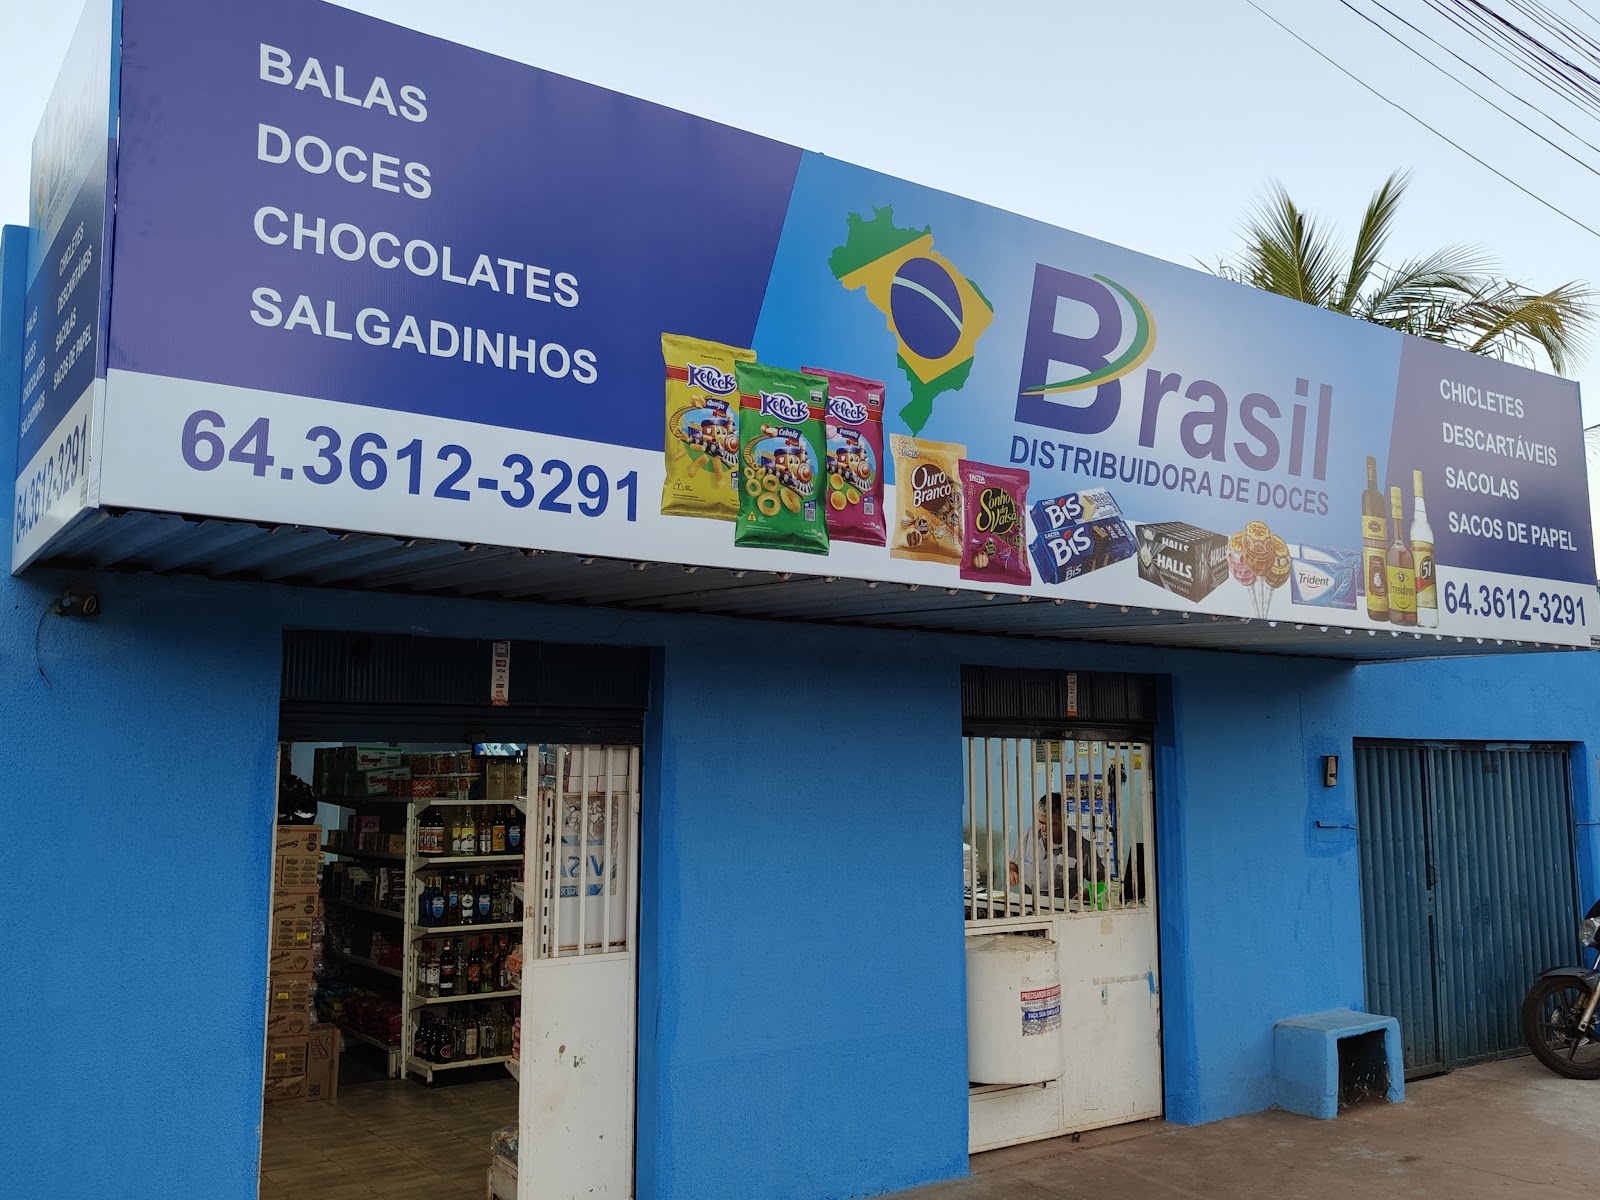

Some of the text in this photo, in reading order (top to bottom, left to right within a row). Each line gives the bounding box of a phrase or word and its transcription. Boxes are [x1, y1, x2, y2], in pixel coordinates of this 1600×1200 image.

[259, 42, 428, 123] BALAS
[257, 122, 432, 200] DOCES
[253, 206, 579, 308] CHOCOLATES
[249, 286, 598, 384] SALGADINHOS
[1014, 262, 1333, 481] Brasil
[1439, 378, 1525, 420] CHICLETES
[181, 409, 638, 523] 64.3612-3291
[1442, 420, 1558, 468] DESCARTÁVEIS
[911, 465, 946, 490] Ouro
[913, 484, 952, 508] Branco
[1010, 435, 1329, 516] DISTRIBUIDORA DE DOCES
[1445, 466, 1520, 501] SACOLAS
[1448, 510, 1578, 552] SACOS DE PAPEL
[1157, 554, 1193, 579] HALLS
[1299, 573, 1329, 587] Trident
[1421, 560, 1431, 579] 51
[1444, 580, 1586, 627] 64.3612-3291
